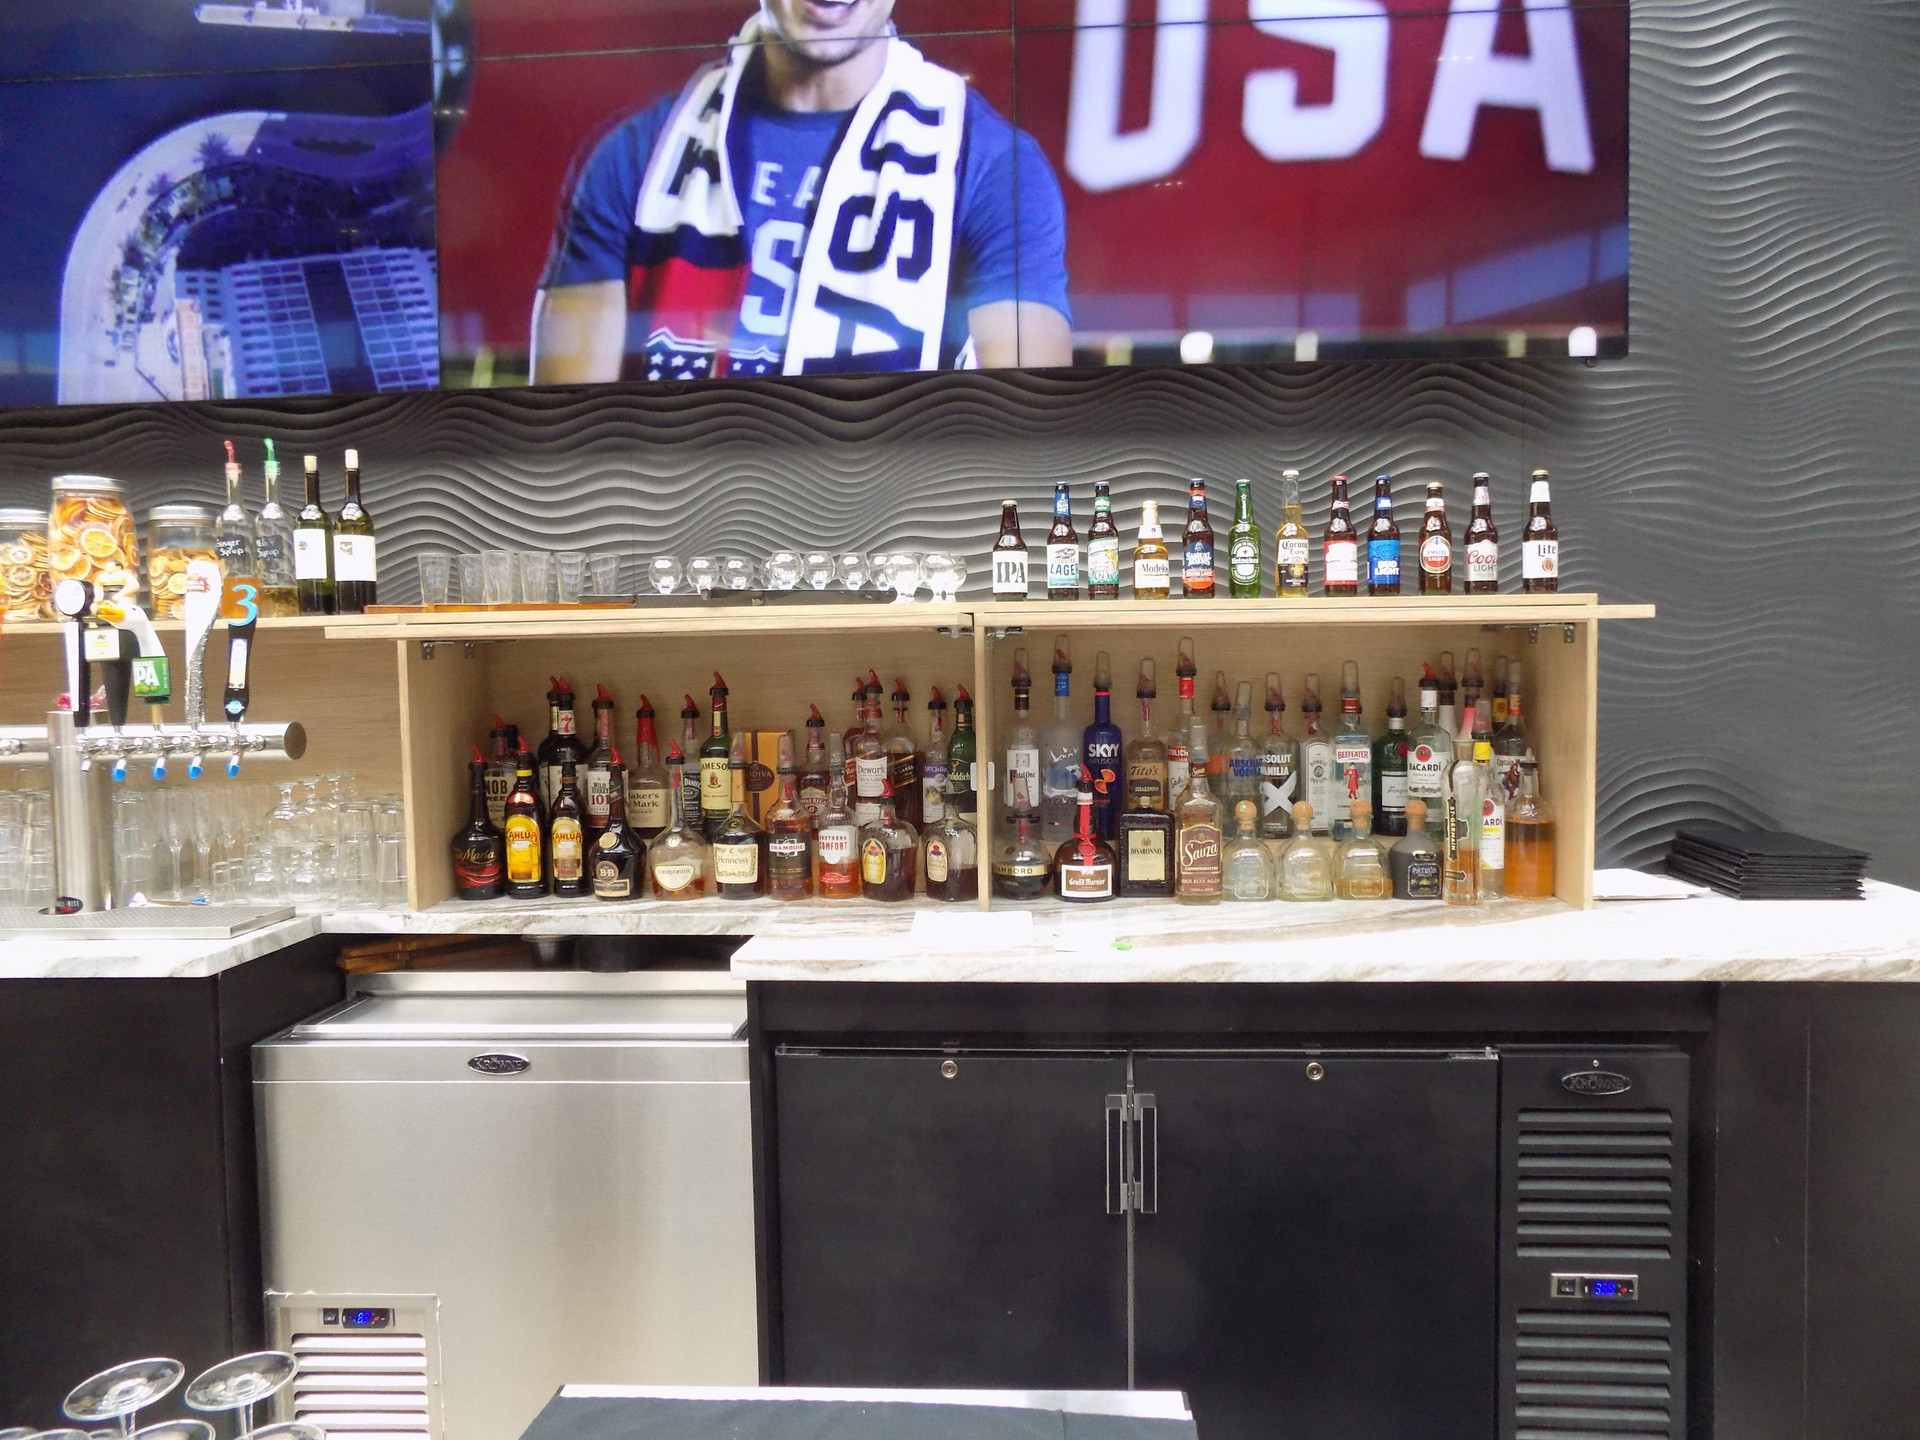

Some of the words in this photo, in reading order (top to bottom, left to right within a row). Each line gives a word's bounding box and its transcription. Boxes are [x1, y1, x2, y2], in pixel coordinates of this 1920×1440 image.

[1065, 0, 1595, 193] USA
[803, 89, 945, 374] USA
[1538, 544, 1556, 557] Lite
[996, 561, 1026, 584] IPA
[1375, 567, 1400, 576] LIGHT
[226, 584, 258, 627] 3
[1088, 743, 1120, 758] SKYY
[1337, 751, 1369, 760] BEEFEATER
[702, 762, 730, 771] AMESO
[858, 766, 886, 774] Dewar's
[1130, 764, 1159, 776] Tito's
[1409, 762, 1441, 772] BACARDÍ
[949, 772, 971, 781] nfiddich
[487, 780, 508, 794] NOB
[592, 795, 611, 805] 101
[633, 800, 660, 808] Mark
[1484, 816, 1502, 827] ARDÍ
[506, 829, 539, 845] KAHLÚA
[819, 842, 848, 850] COMFORT
[1131, 848, 1162, 856] DISARONNO
[1182, 843, 1219, 867] Sauza
[718, 856, 750, 865] Hennessy
[474, 1057, 523, 1070] KROWNE
[1569, 1076, 1625, 1090] KROWNE
